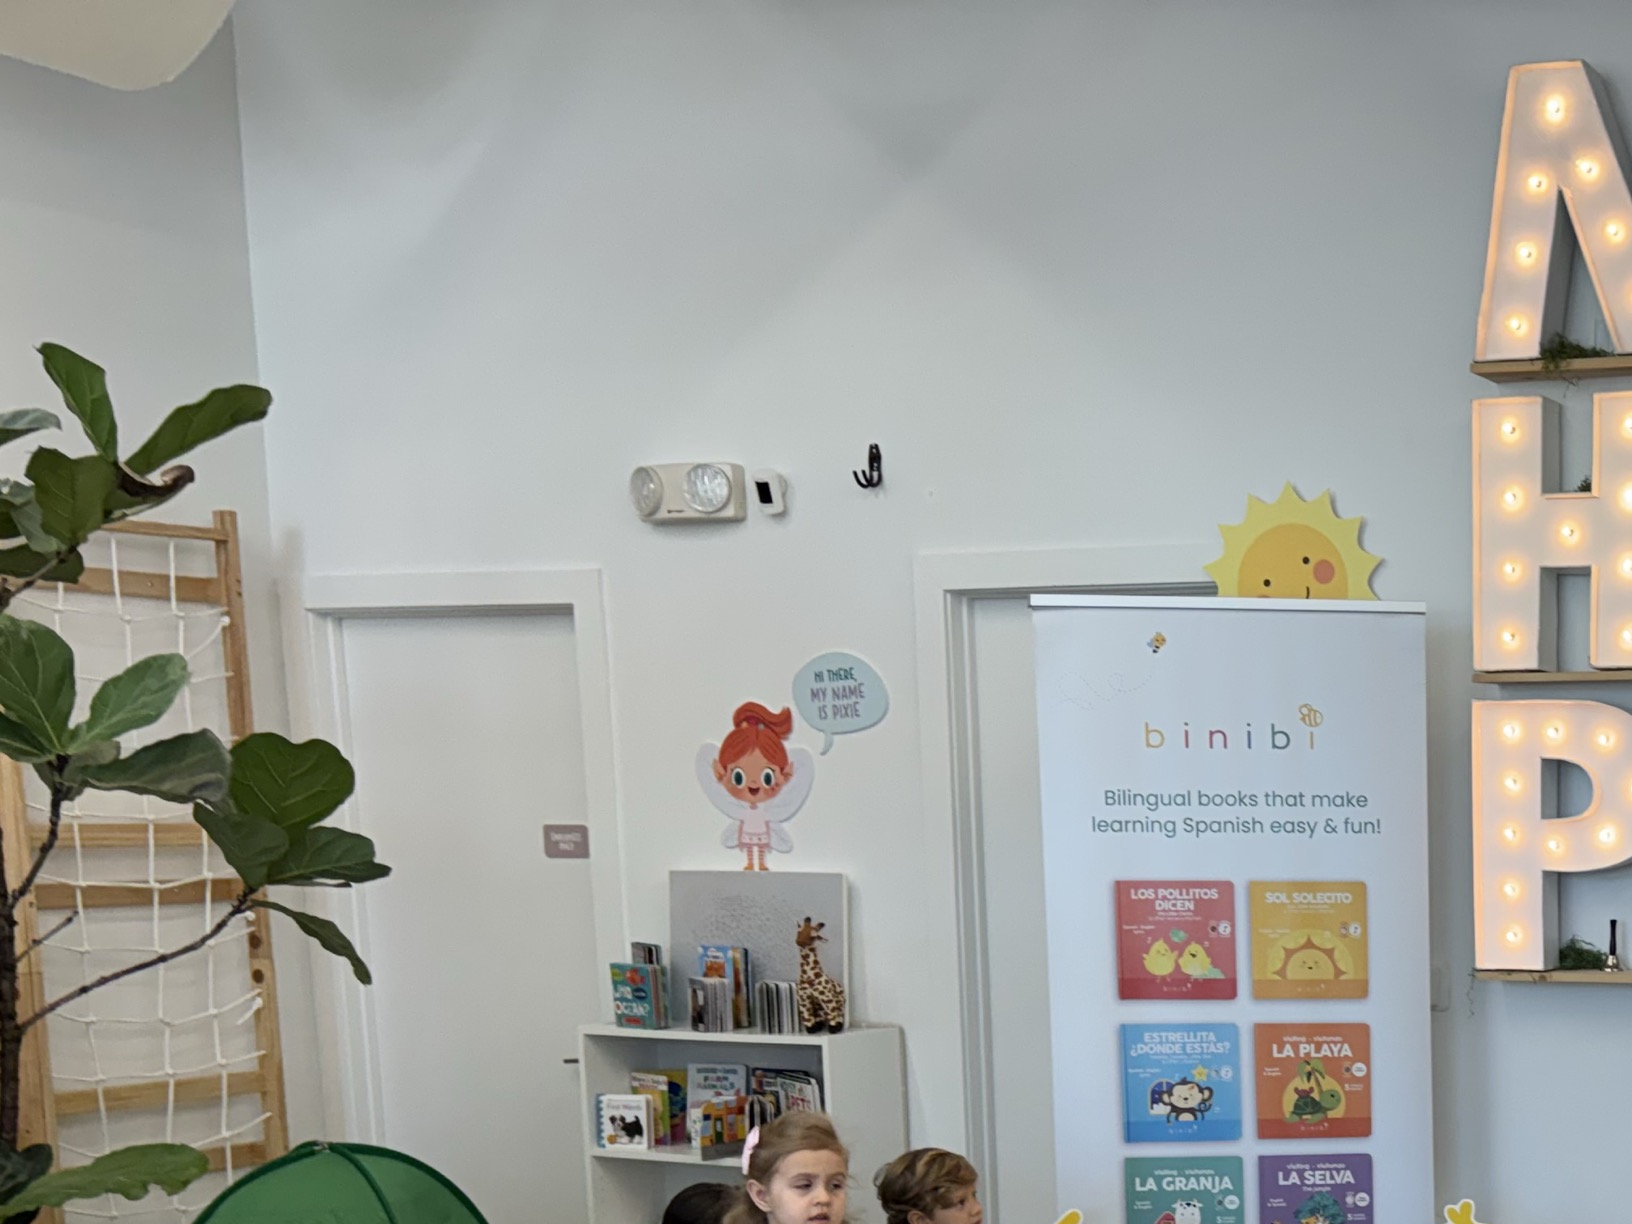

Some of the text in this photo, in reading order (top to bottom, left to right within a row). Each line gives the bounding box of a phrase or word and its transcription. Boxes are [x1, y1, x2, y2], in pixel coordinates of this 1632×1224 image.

[814, 670, 824, 683] HI
[810, 683, 865, 702] MY NAME
[818, 701, 861, 720] IS PIXIE
[1144, 721, 1316, 751] binibi
[1104, 789, 1368, 812] Bilingual books that make
[1091, 816, 1382, 839] learning Spanish easy & fun!
[1130, 888, 1219, 900] LOS POLLITOS
[1265, 892, 1353, 904] SOL SOLECITO
[1155, 900, 1195, 911] DICEN
[1143, 1031, 1217, 1043] ESTRELLITA
[1272, 1043, 1353, 1058] LA PLAYA
[1135, 1176, 1234, 1193] LA GRANJA
[1278, 1170, 1355, 1185] LA SELVA
